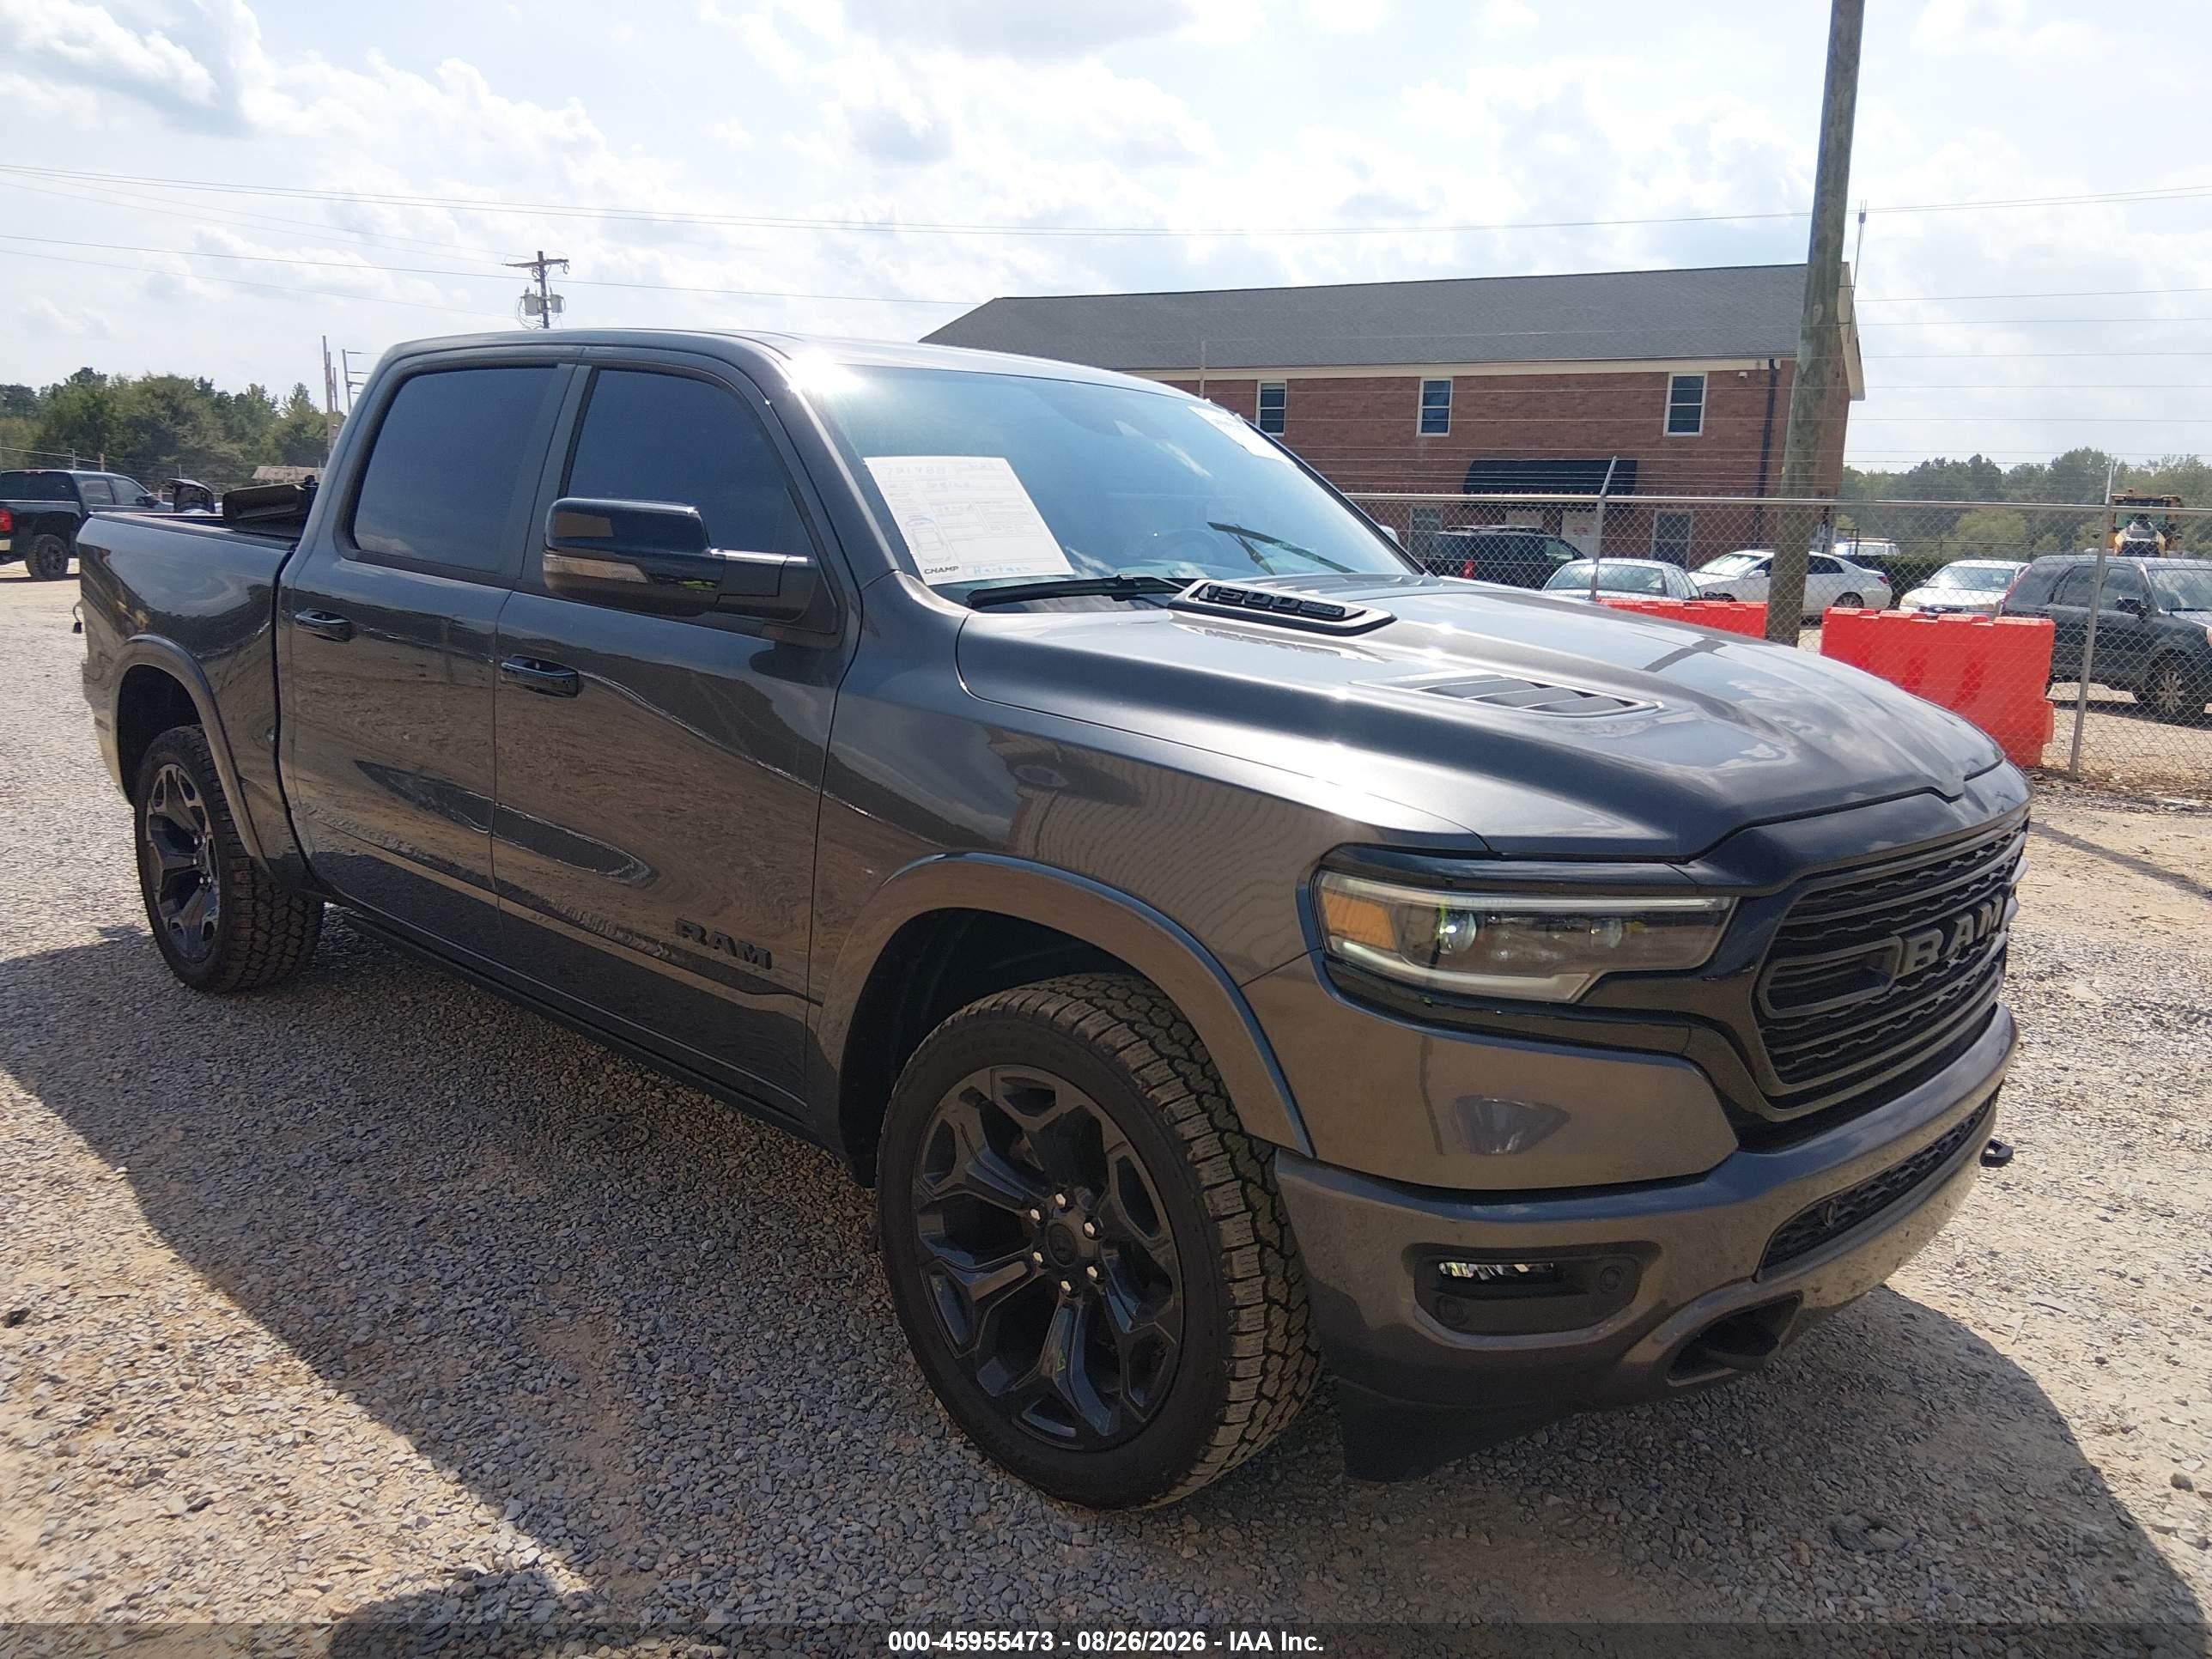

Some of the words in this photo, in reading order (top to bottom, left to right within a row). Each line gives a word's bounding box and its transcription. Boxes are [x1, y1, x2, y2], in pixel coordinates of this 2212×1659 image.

[924, 566, 959, 574] CHAMP
[1207, 585, 1303, 613] 1500
[675, 918, 773, 970] RAM
[1899, 893, 2004, 976] RAM
